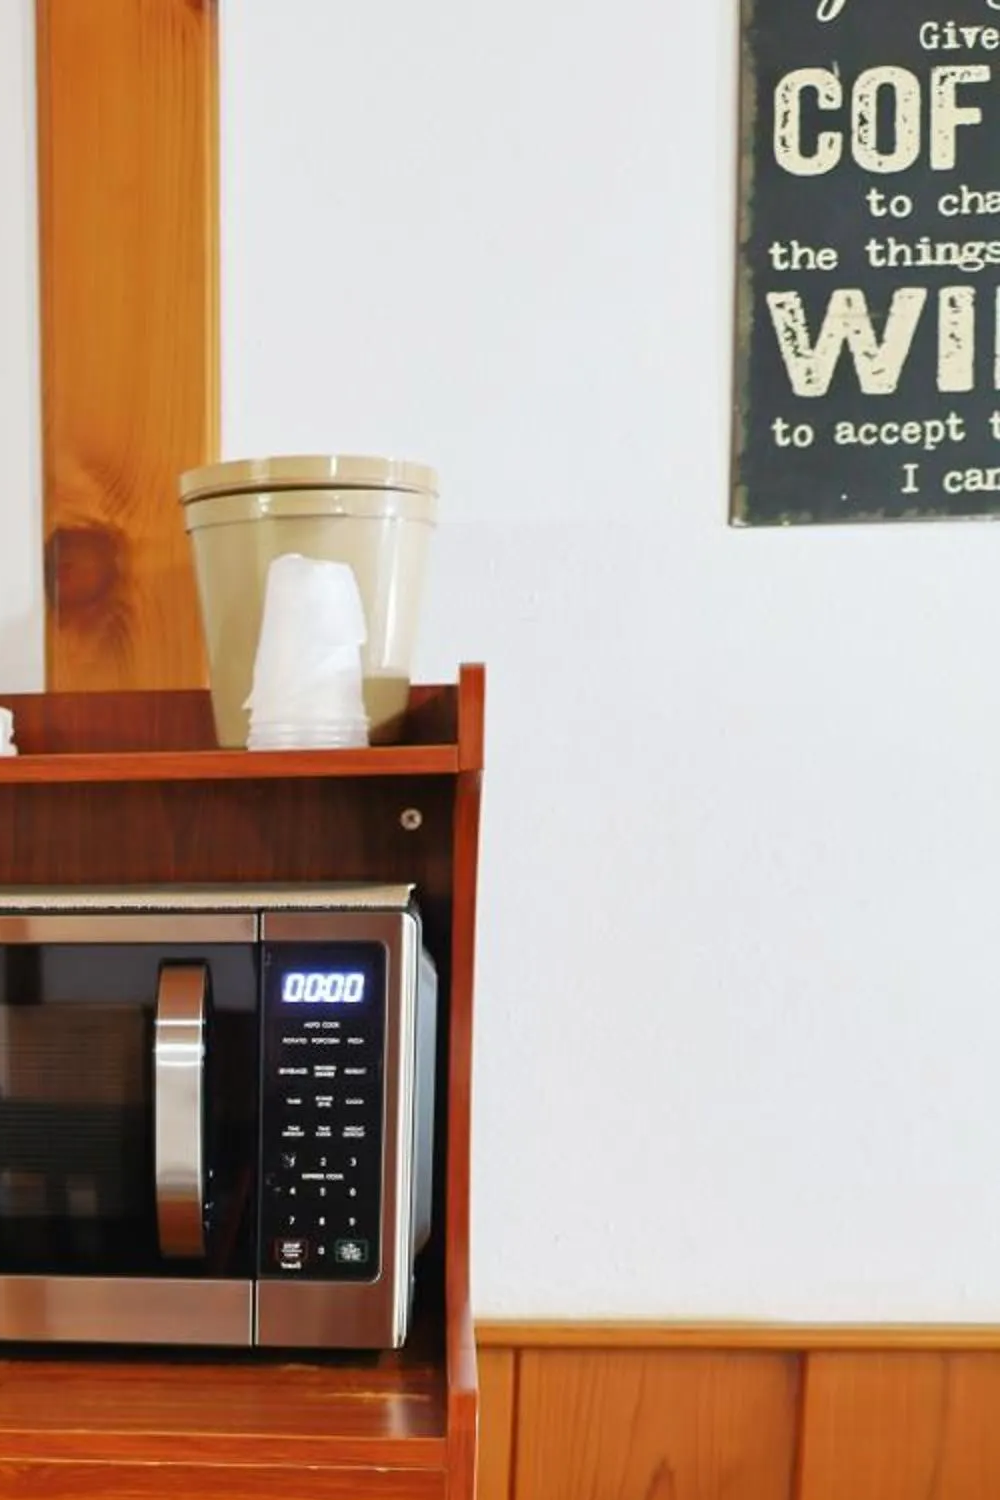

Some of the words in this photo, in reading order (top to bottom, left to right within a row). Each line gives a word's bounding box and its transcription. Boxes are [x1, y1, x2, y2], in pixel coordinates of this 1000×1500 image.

[919, 20, 1000, 50] Give
[773, 64, 991, 176] COF
[866, 187, 912, 218] to
[937, 184, 1000, 217] cha
[768, 239, 838, 271] the
[865, 236, 1000, 272] things
[766, 285, 1000, 398] WI
[772, 417, 814, 448] to
[834, 411, 966, 451] accept
[901, 463, 919, 494] I
